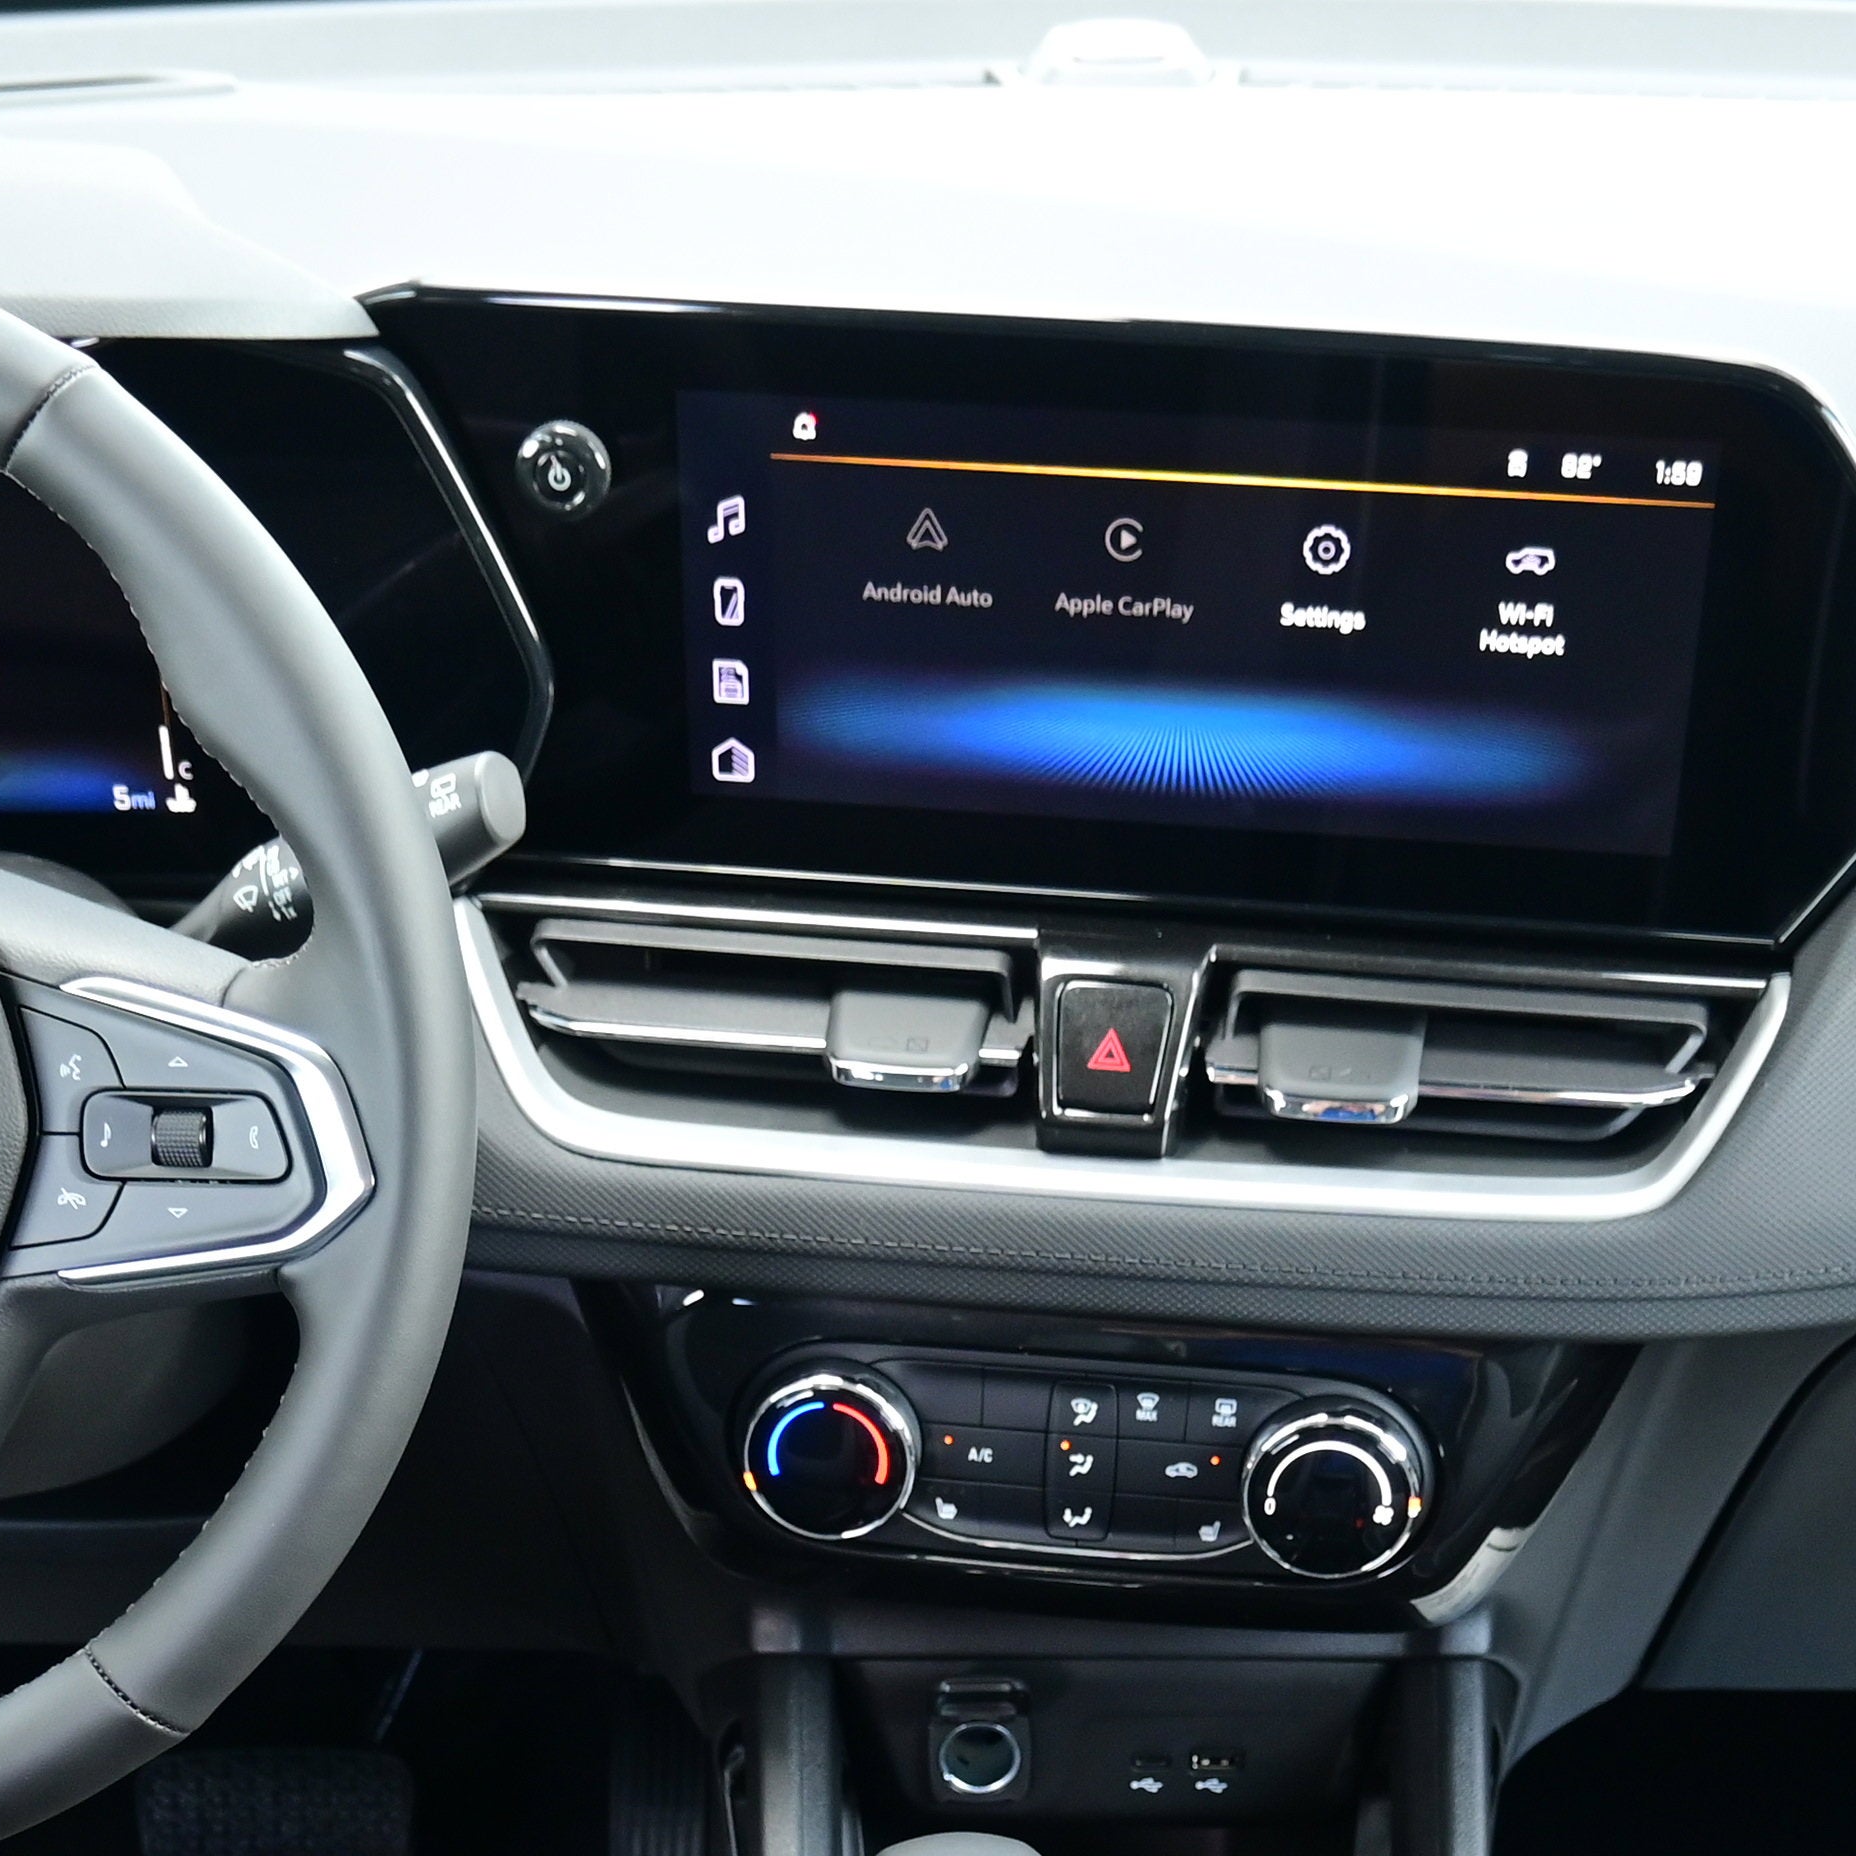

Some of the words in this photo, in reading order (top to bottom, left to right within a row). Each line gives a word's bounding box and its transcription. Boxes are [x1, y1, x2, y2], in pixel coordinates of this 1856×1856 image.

[862, 581, 942, 605] Android
[945, 586, 993, 608] Auto
[1054, 592, 1113, 618] Apple
[1117, 596, 1194, 624] CarPlay
[1280, 602, 1366, 634] Settings
[1479, 628, 1565, 659] Hotspot
[178, 760, 194, 781] C
[1136, 1409, 1158, 1422] MAX
[968, 1447, 993, 1463] A/C
[1264, 1497, 1276, 1516] 0
